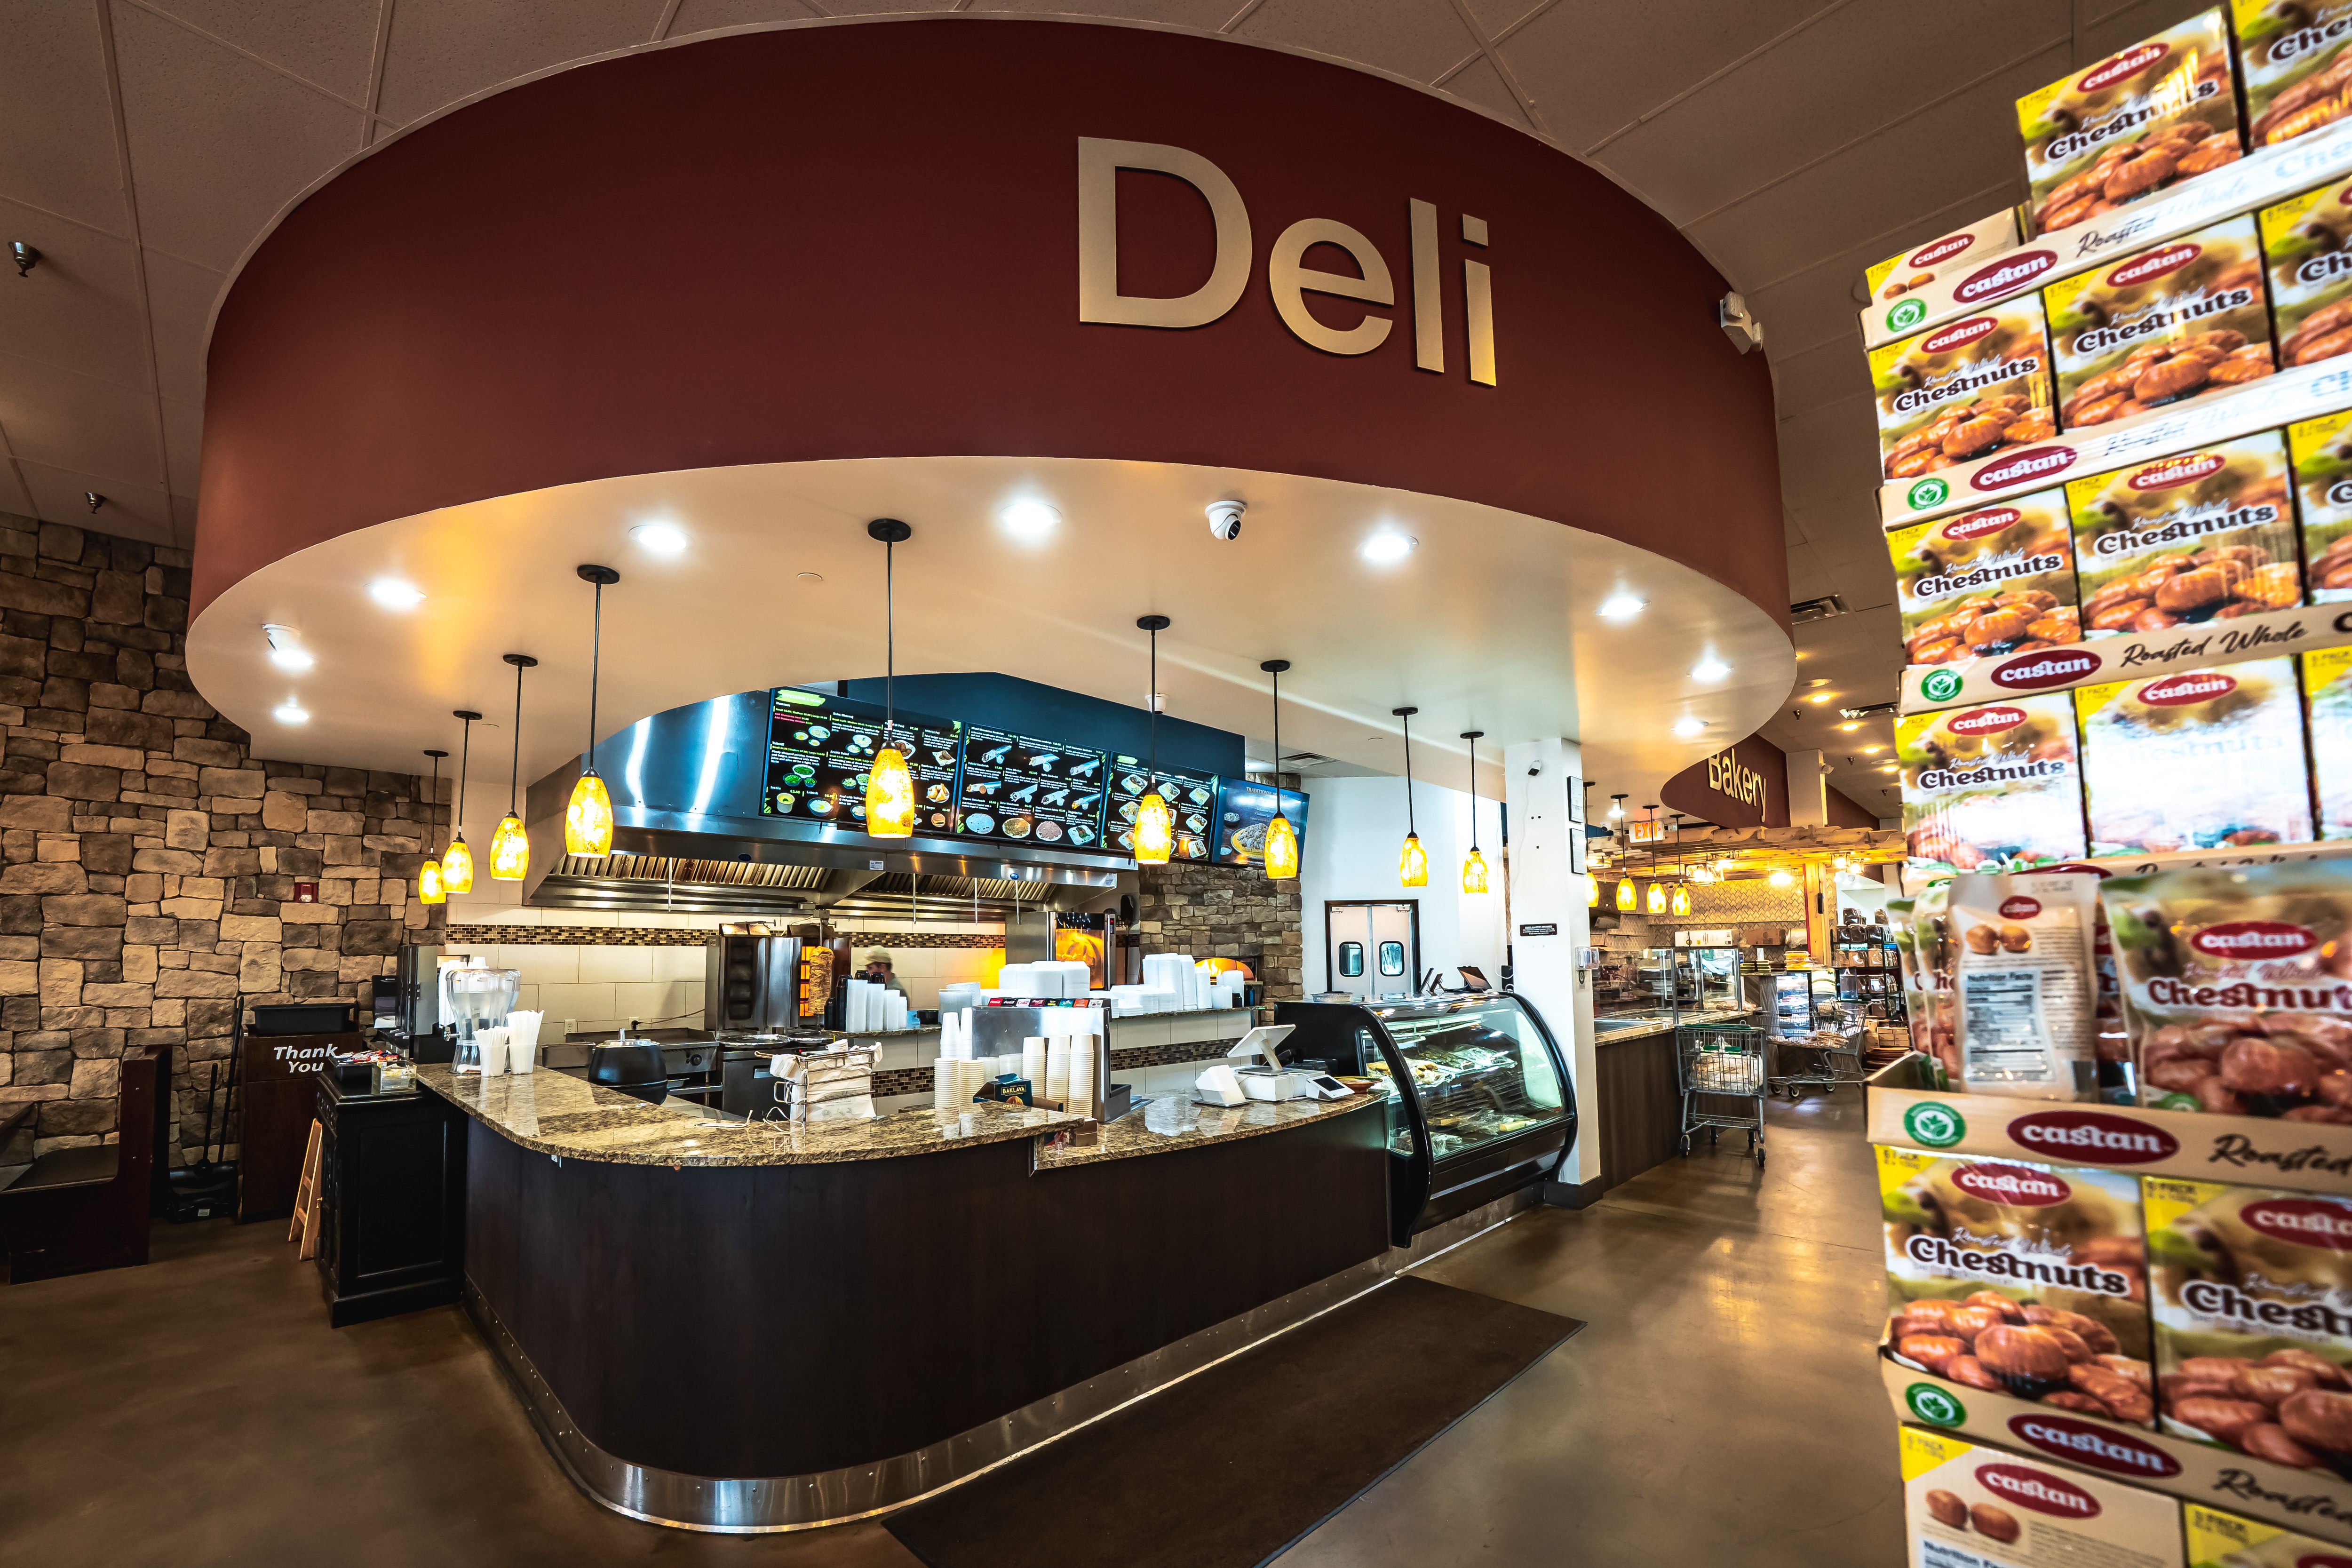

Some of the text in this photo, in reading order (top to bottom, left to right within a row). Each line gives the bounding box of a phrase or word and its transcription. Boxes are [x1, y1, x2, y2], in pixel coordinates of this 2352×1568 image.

[2272, 16, 2352, 60] Che
[1078, 136, 1496, 387] Deli
[1915, 237, 1969, 265] castan
[2114, 246, 2193, 282] castan
[1963, 255, 2049, 297] castan
[1929, 320, 1991, 350] castan
[2076, 288, 2250, 353] Chestnuts
[1896, 358, 2038, 412] Chestnuts
[1980, 452, 2065, 486] castan
[2136, 457, 2217, 487] castan
[1947, 512, 2014, 536] castan
[2097, 505, 2275, 554] Chestnuts
[1916, 555, 2061, 596] Chestnuts
[2120, 635, 2212, 668] Roasted
[2219, 620, 2308, 654] Whole
[2000, 658, 2091, 682] castan
[2145, 678, 2228, 701] castan
[1954, 712, 2019, 730] castan
[1708, 748, 1766, 822] Bakery
[1920, 758, 2066, 789] Chestnuts
[1246, 787, 1272, 795] TRADITIONAL
[1635, 821, 1658, 839] EXIT
[2200, 931, 2305, 948] castan
[274, 1043, 338, 1059] Thank
[289, 1061, 324, 1073] You
[2022, 1125, 2162, 1153] castan
[1961, 1172, 2058, 1197] castan
[1910, 1238, 2128, 1294] Chestnuts
[2185, 1283, 2352, 1337] Chest
[2024, 1423, 2164, 1472] castan
[1986, 1472, 2089, 1514] castan
